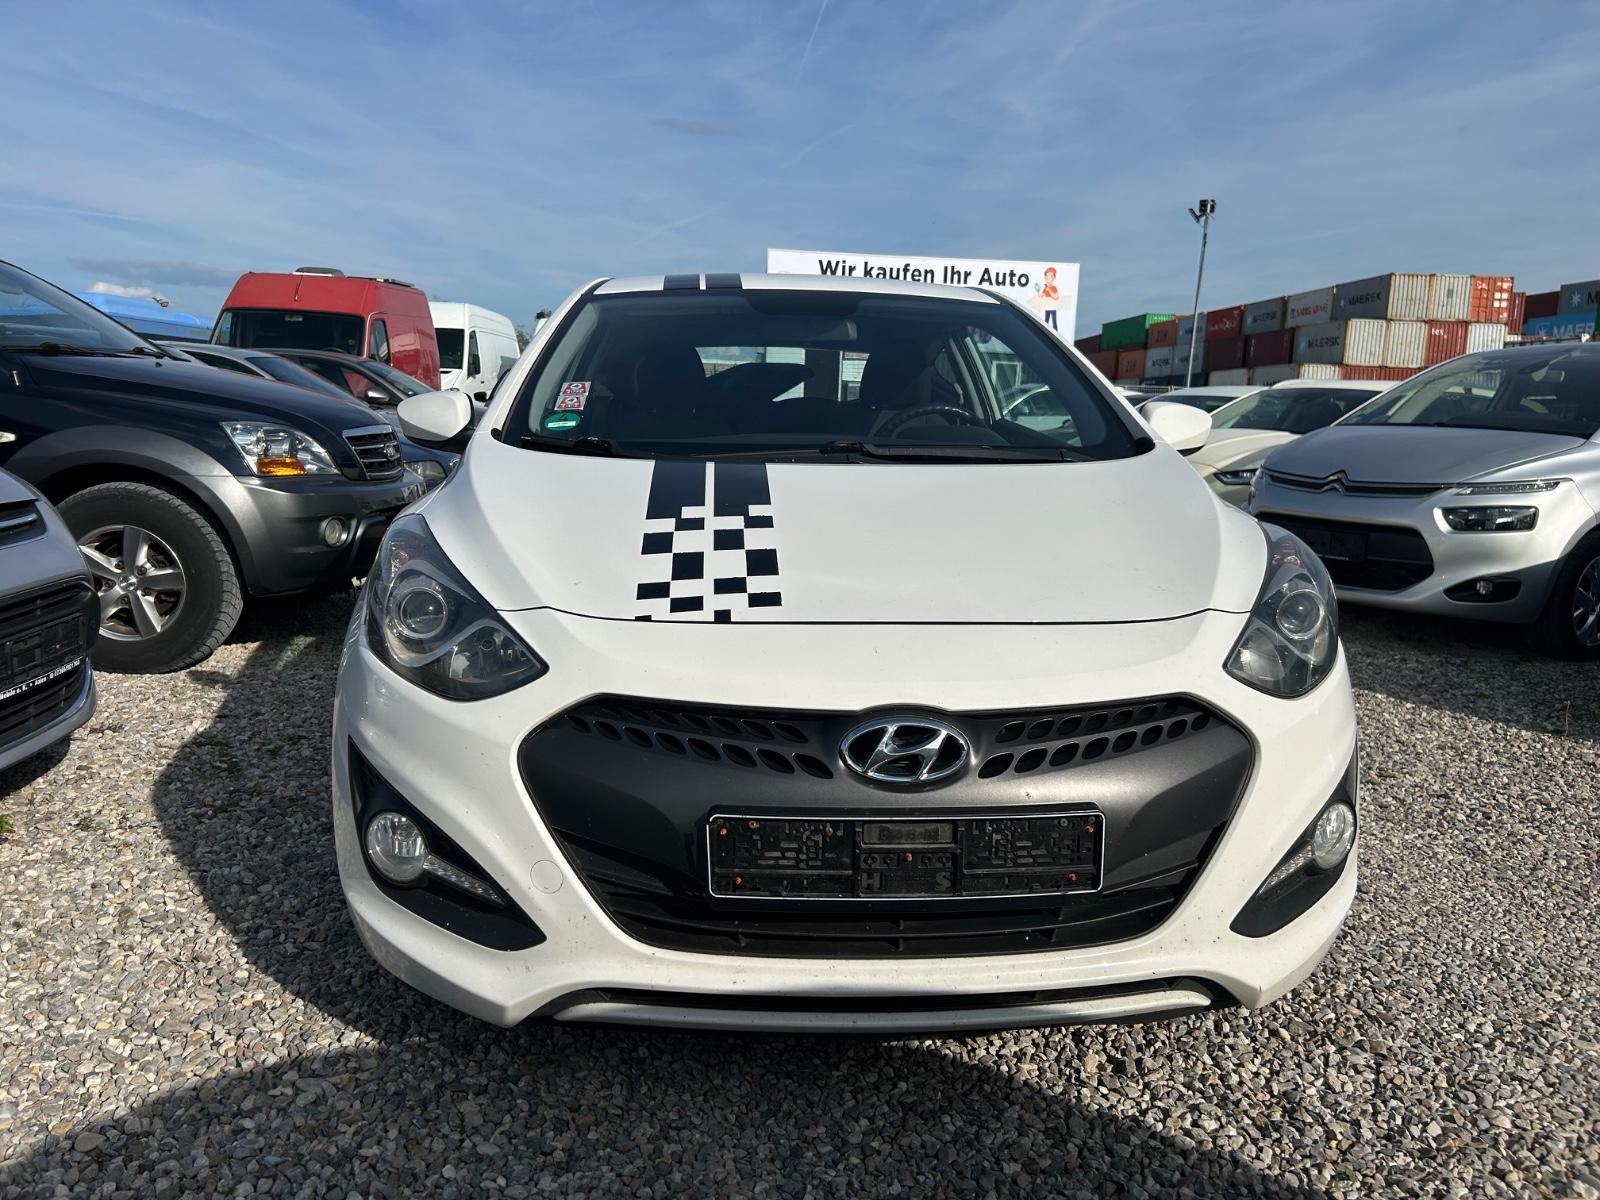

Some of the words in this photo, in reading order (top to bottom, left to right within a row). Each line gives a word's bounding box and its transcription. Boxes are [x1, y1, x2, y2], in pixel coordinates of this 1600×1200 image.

[818, 259, 856, 277] Wir
[863, 262, 935, 284] kaufen
[943, 265, 972, 286] Ihr
[978, 268, 1030, 288] Auto
[1349, 291, 1381, 306] MAERSK
[1552, 321, 1595, 337] MAER
[1307, 336, 1340, 349] MAERSK
